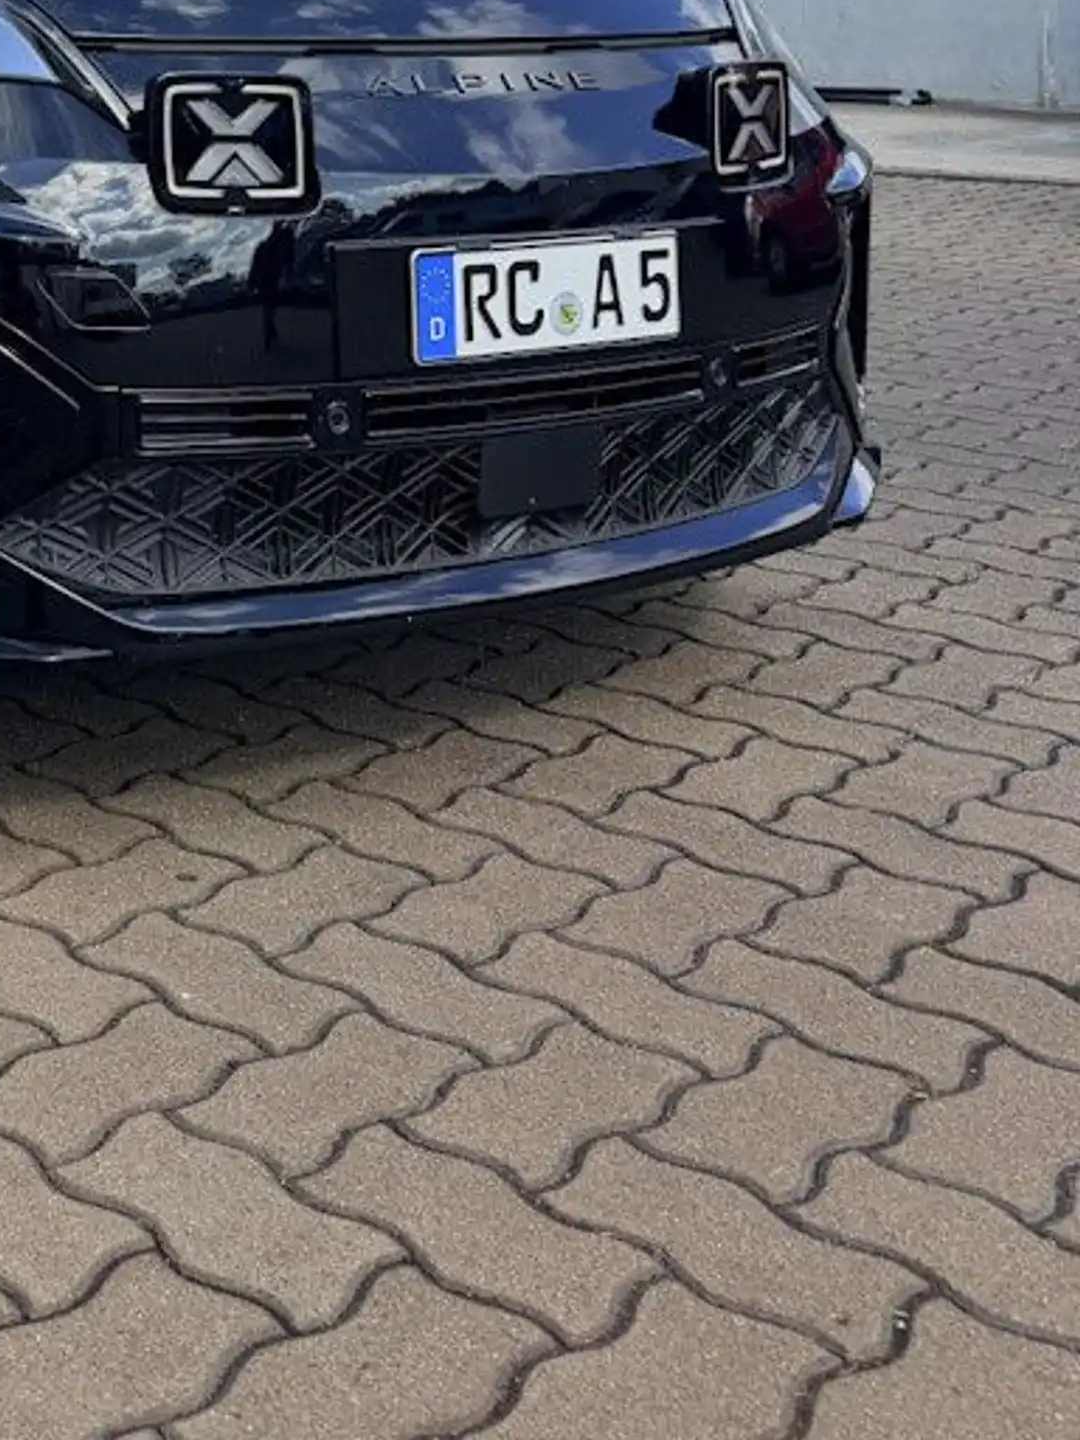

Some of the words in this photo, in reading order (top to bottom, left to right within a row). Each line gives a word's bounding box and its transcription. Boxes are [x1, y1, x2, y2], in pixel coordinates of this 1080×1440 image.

[368, 70, 601, 97] ALPINE
[462, 261, 544, 341] RC
[430, 317, 446, 341] D
